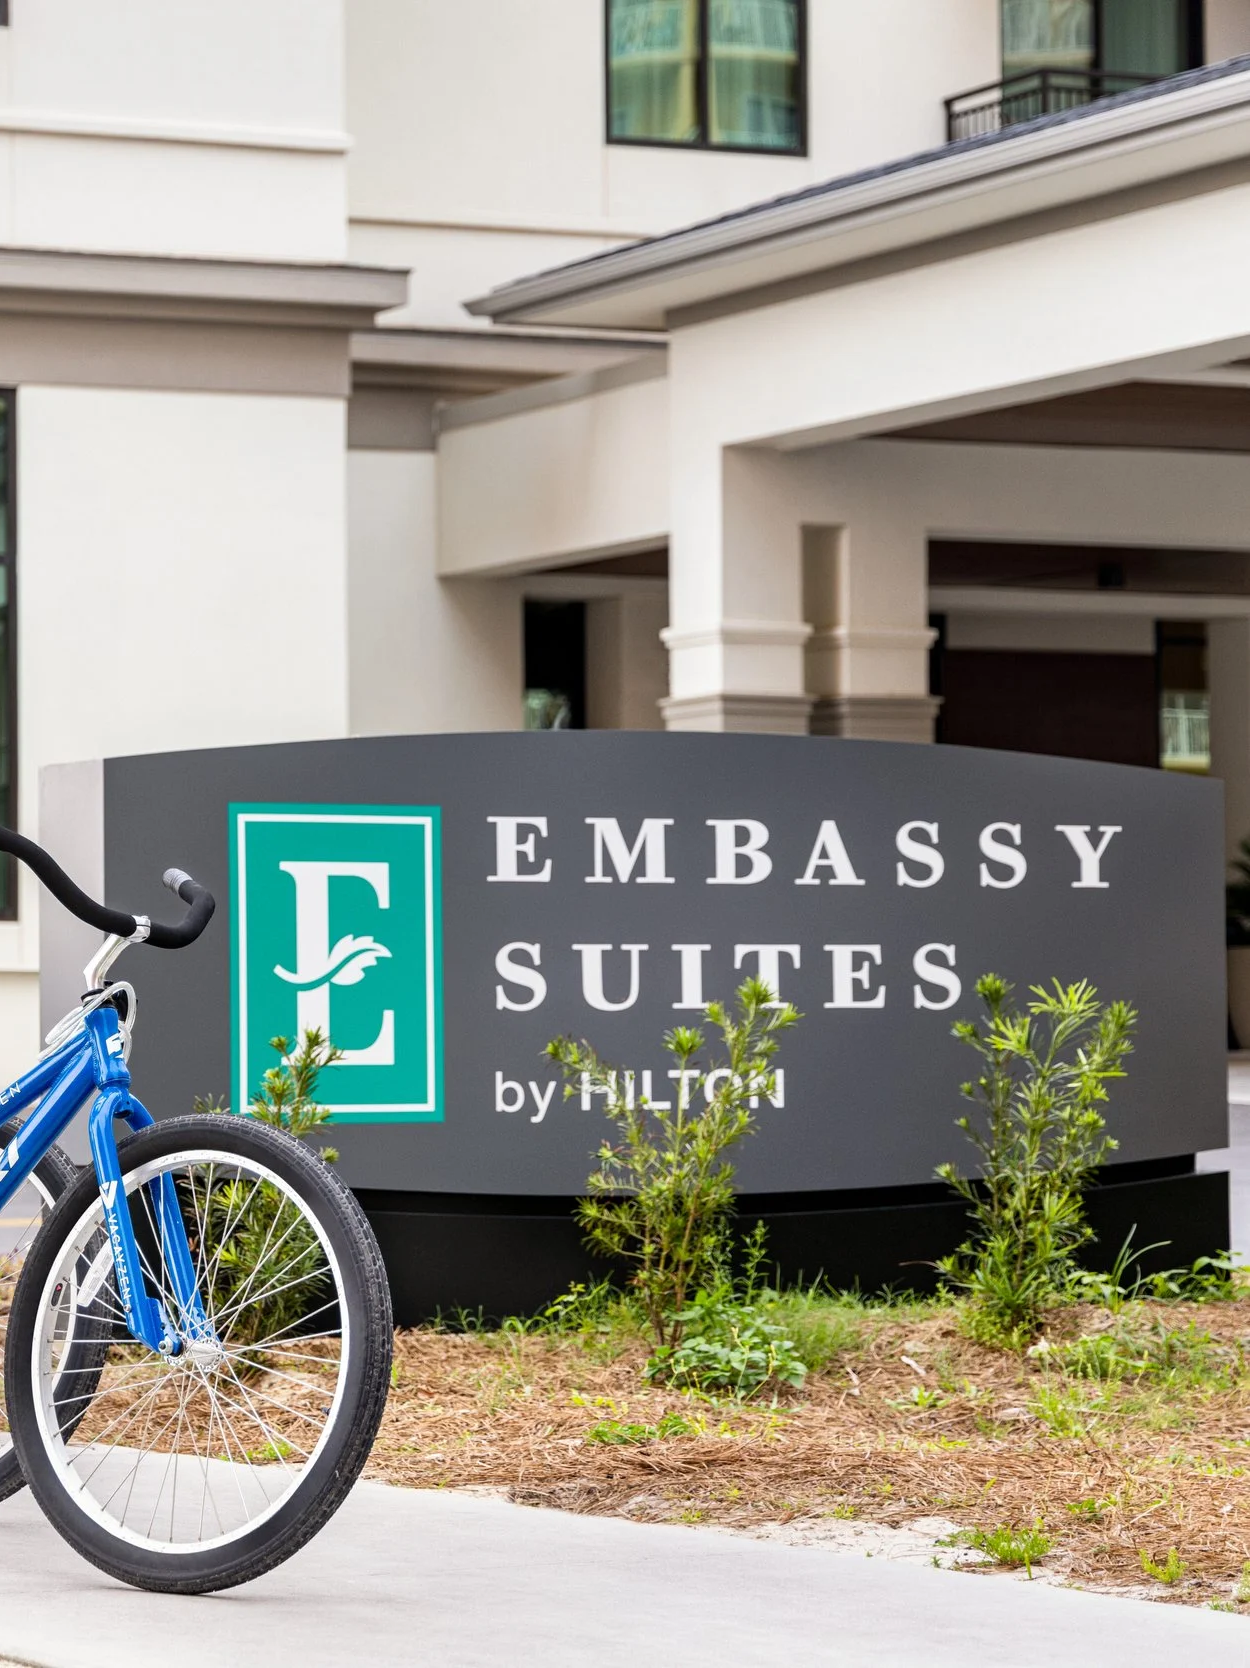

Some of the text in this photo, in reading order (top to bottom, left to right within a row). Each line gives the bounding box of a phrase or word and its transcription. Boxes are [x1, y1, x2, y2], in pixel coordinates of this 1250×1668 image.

[485, 815, 1124, 890] EMBASSY
[494, 941, 963, 1013] SUITES
[494, 1067, 786, 1124] by HILTON
[107, 1213, 133, 1299] VACAYZEN
